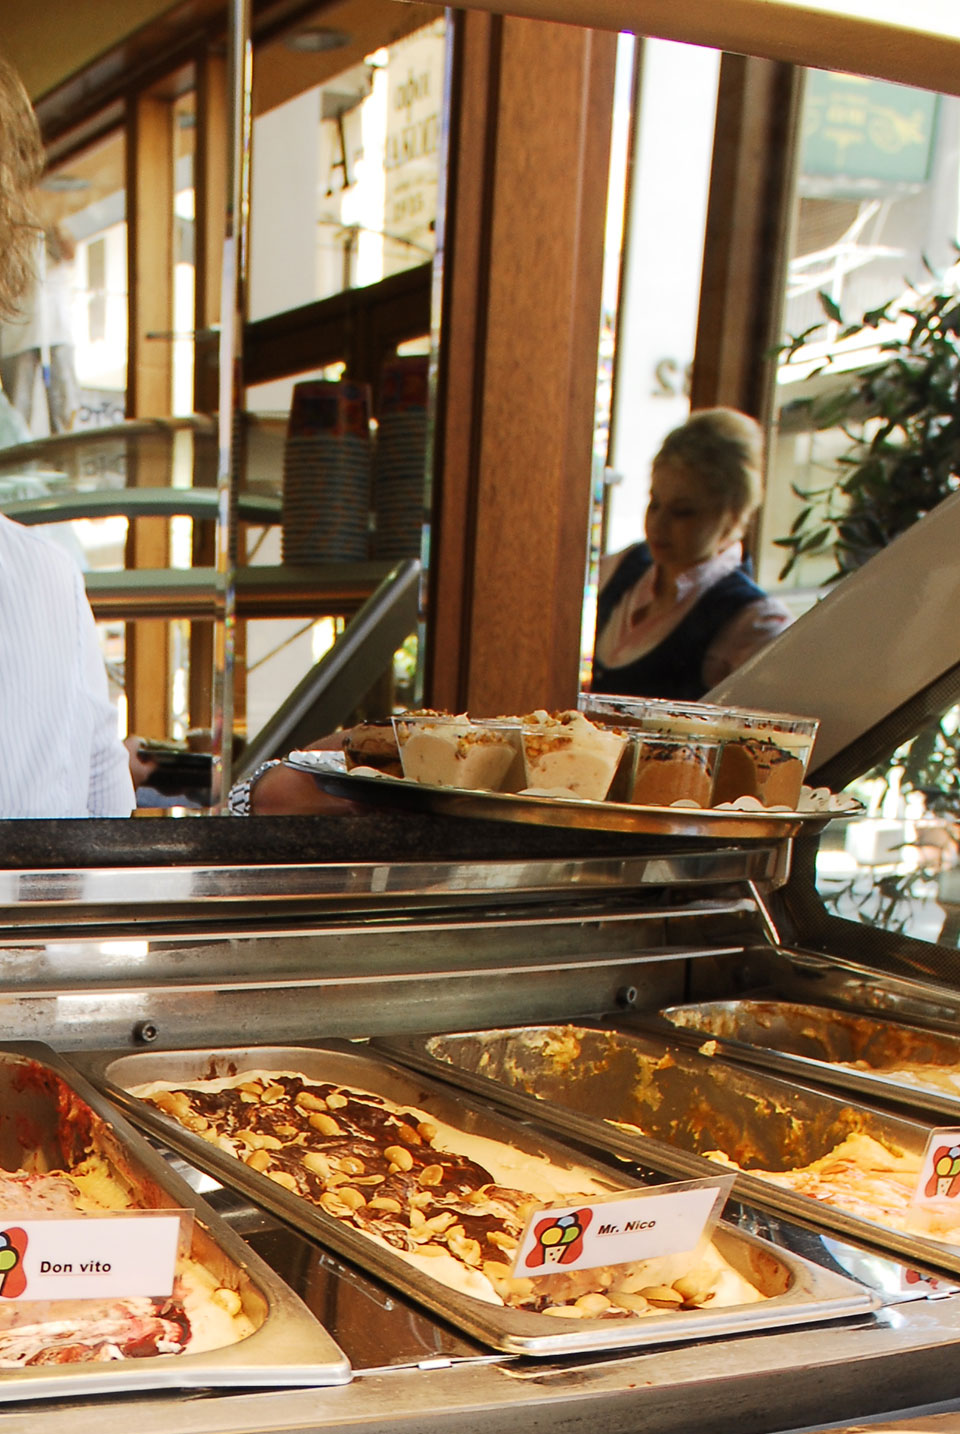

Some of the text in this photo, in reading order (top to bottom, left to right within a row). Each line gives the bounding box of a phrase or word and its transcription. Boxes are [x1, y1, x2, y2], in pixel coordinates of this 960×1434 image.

[597, 1220, 656, 1235] Mr. Nico
[40, 1260, 112, 1273] Don vito
